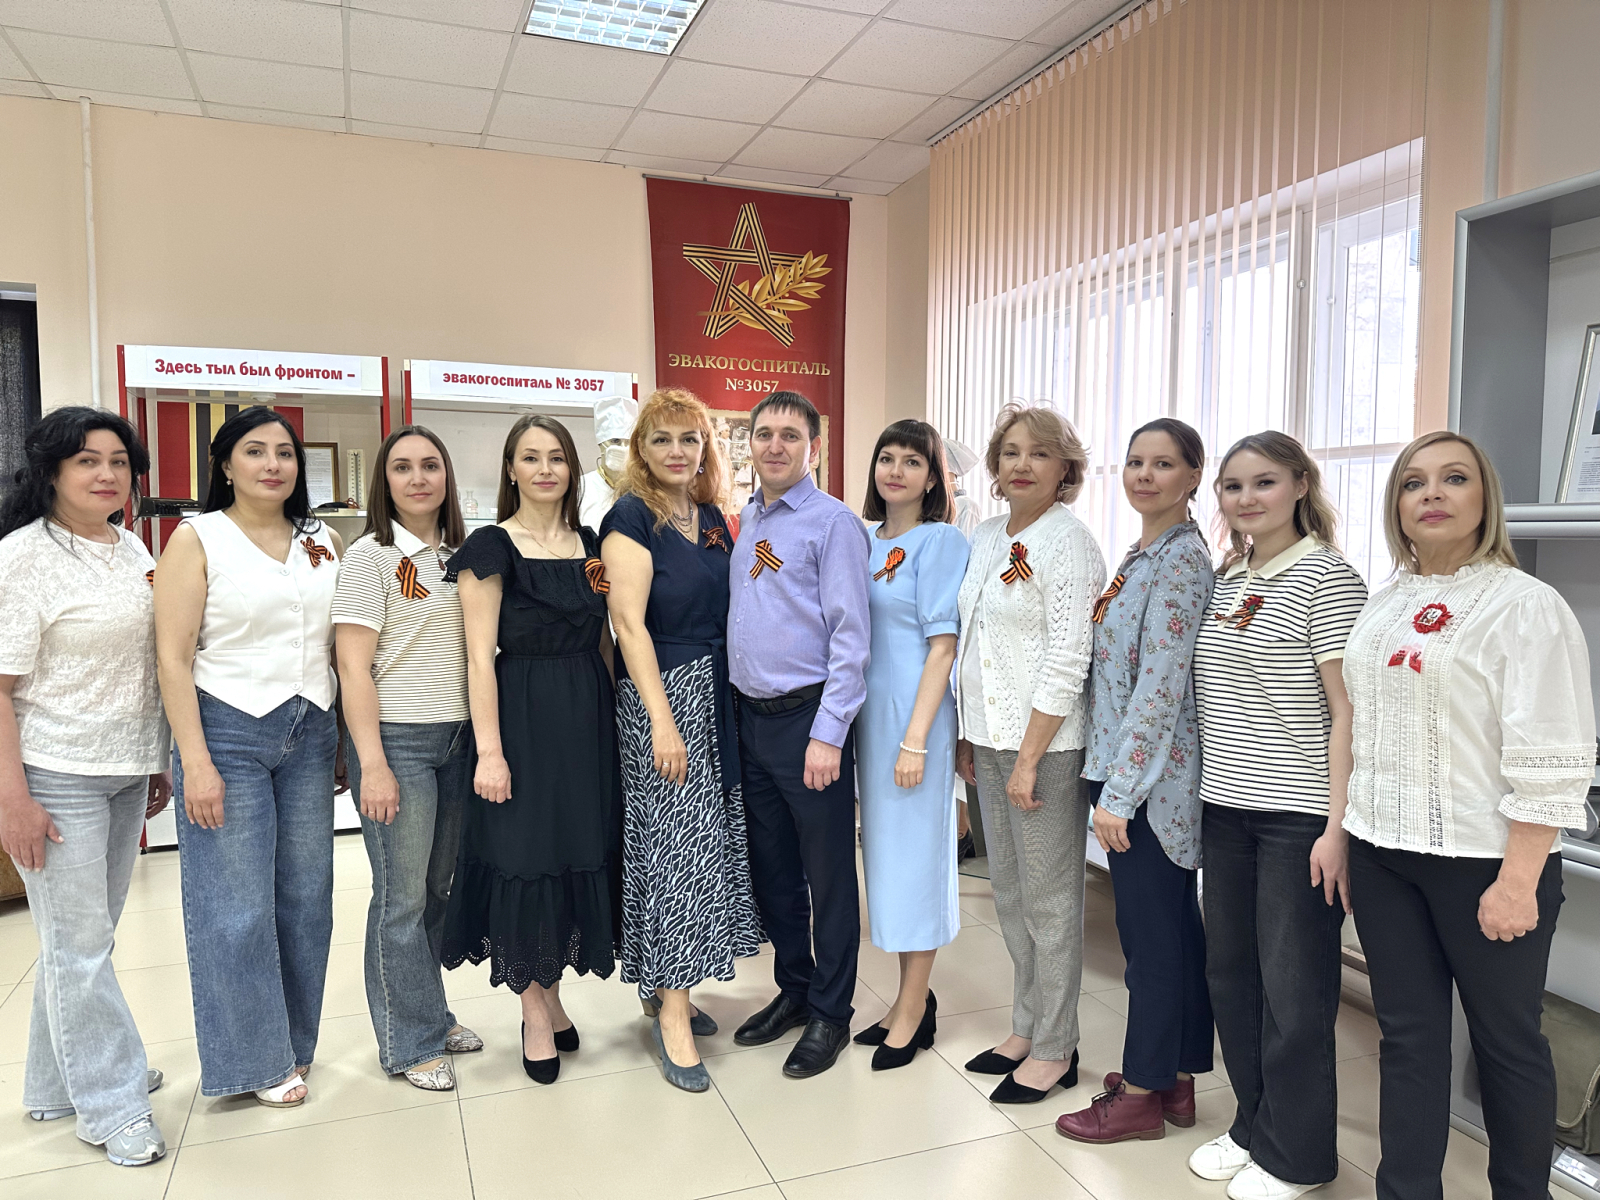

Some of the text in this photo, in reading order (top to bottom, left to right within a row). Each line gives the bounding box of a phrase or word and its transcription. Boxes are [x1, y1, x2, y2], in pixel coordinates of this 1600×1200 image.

[155, 359, 202, 375] Здесь
[205, 364, 236, 376] тыл
[239, 361, 271, 377] был
[275, 364, 343, 380] фронтом
[668, 353, 831, 376] ЭВАКОГОСПИТАЛЬ
[443, 373, 605, 392] эвакогоспиталь № 3057
[725, 378, 779, 392] №3057
